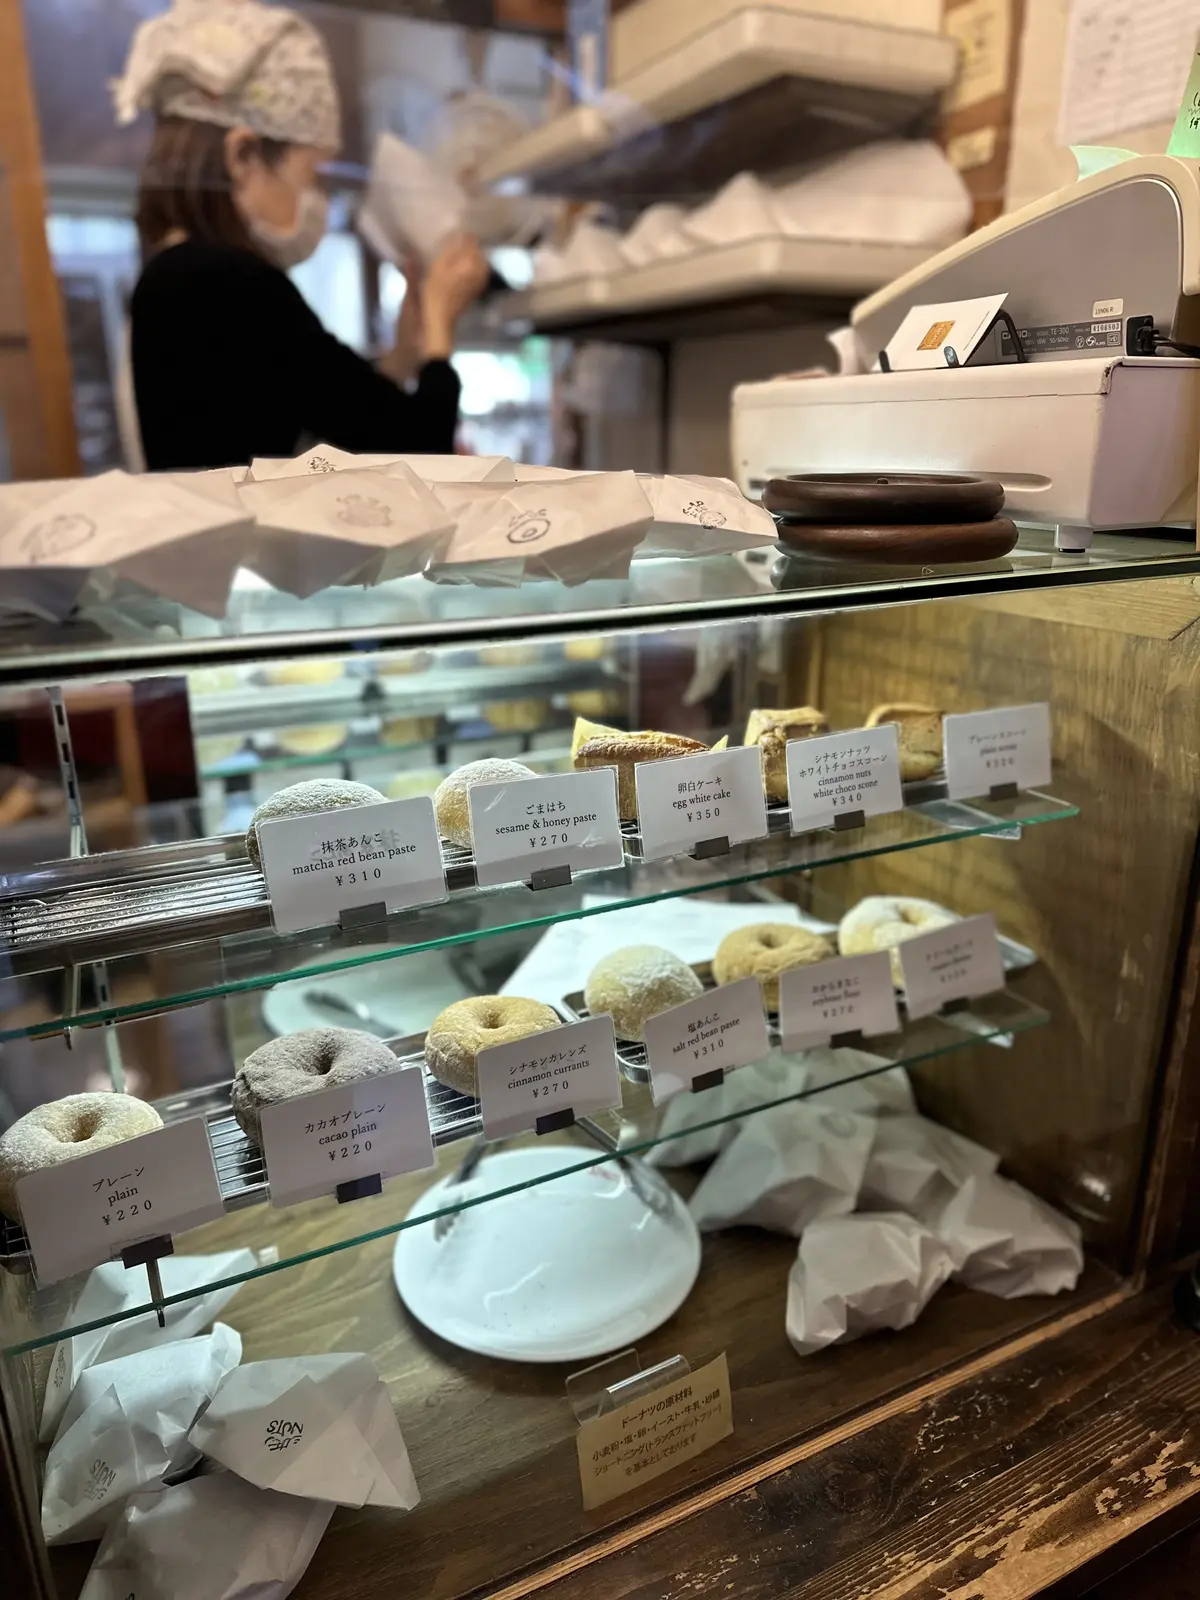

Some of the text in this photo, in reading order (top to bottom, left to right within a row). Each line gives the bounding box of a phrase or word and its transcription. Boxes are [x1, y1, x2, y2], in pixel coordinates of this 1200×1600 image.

[815, 745, 871, 764] シナモンナッツ
[799, 754, 888, 778] ホワイトチョコスコーン
[677, 776, 722, 794] 卵白ケーキ
[818, 769, 872, 786] cinnamon nuts
[672, 789, 731, 810] egg white cake
[813, 780, 879, 799] white choco scone
[526, 800, 566, 815] ごまはち
[687, 807, 720, 822] ¥350
[495, 813, 598, 835] sesame & honey paste
[321, 832, 383, 855] 抹茶あんこ
[529, 832, 568, 848] ¥270
[292, 844, 417, 875] matcha red bean paste
[335, 868, 381, 887] ¥310
[688, 1013, 720, 1033] 塩あんこ
[672, 1018, 740, 1053] salt red bean paste
[509, 1044, 586, 1075] シナモンカレンズ
[693, 1039, 724, 1059] ¥310
[507, 1060, 590, 1089] cinnamon currants
[533, 1080, 569, 1098] ¥270
[305, 1103, 386, 1134] カカオプレーン
[319, 1122, 377, 1145] cacao plain
[328, 1140, 372, 1161] ¥220
[93, 1166, 145, 1192] プレーン
[108, 1187, 138, 1207] plain
[102, 1199, 152, 1226] ¥220
[622, 1386, 693, 1429] ドーナツの原材料
